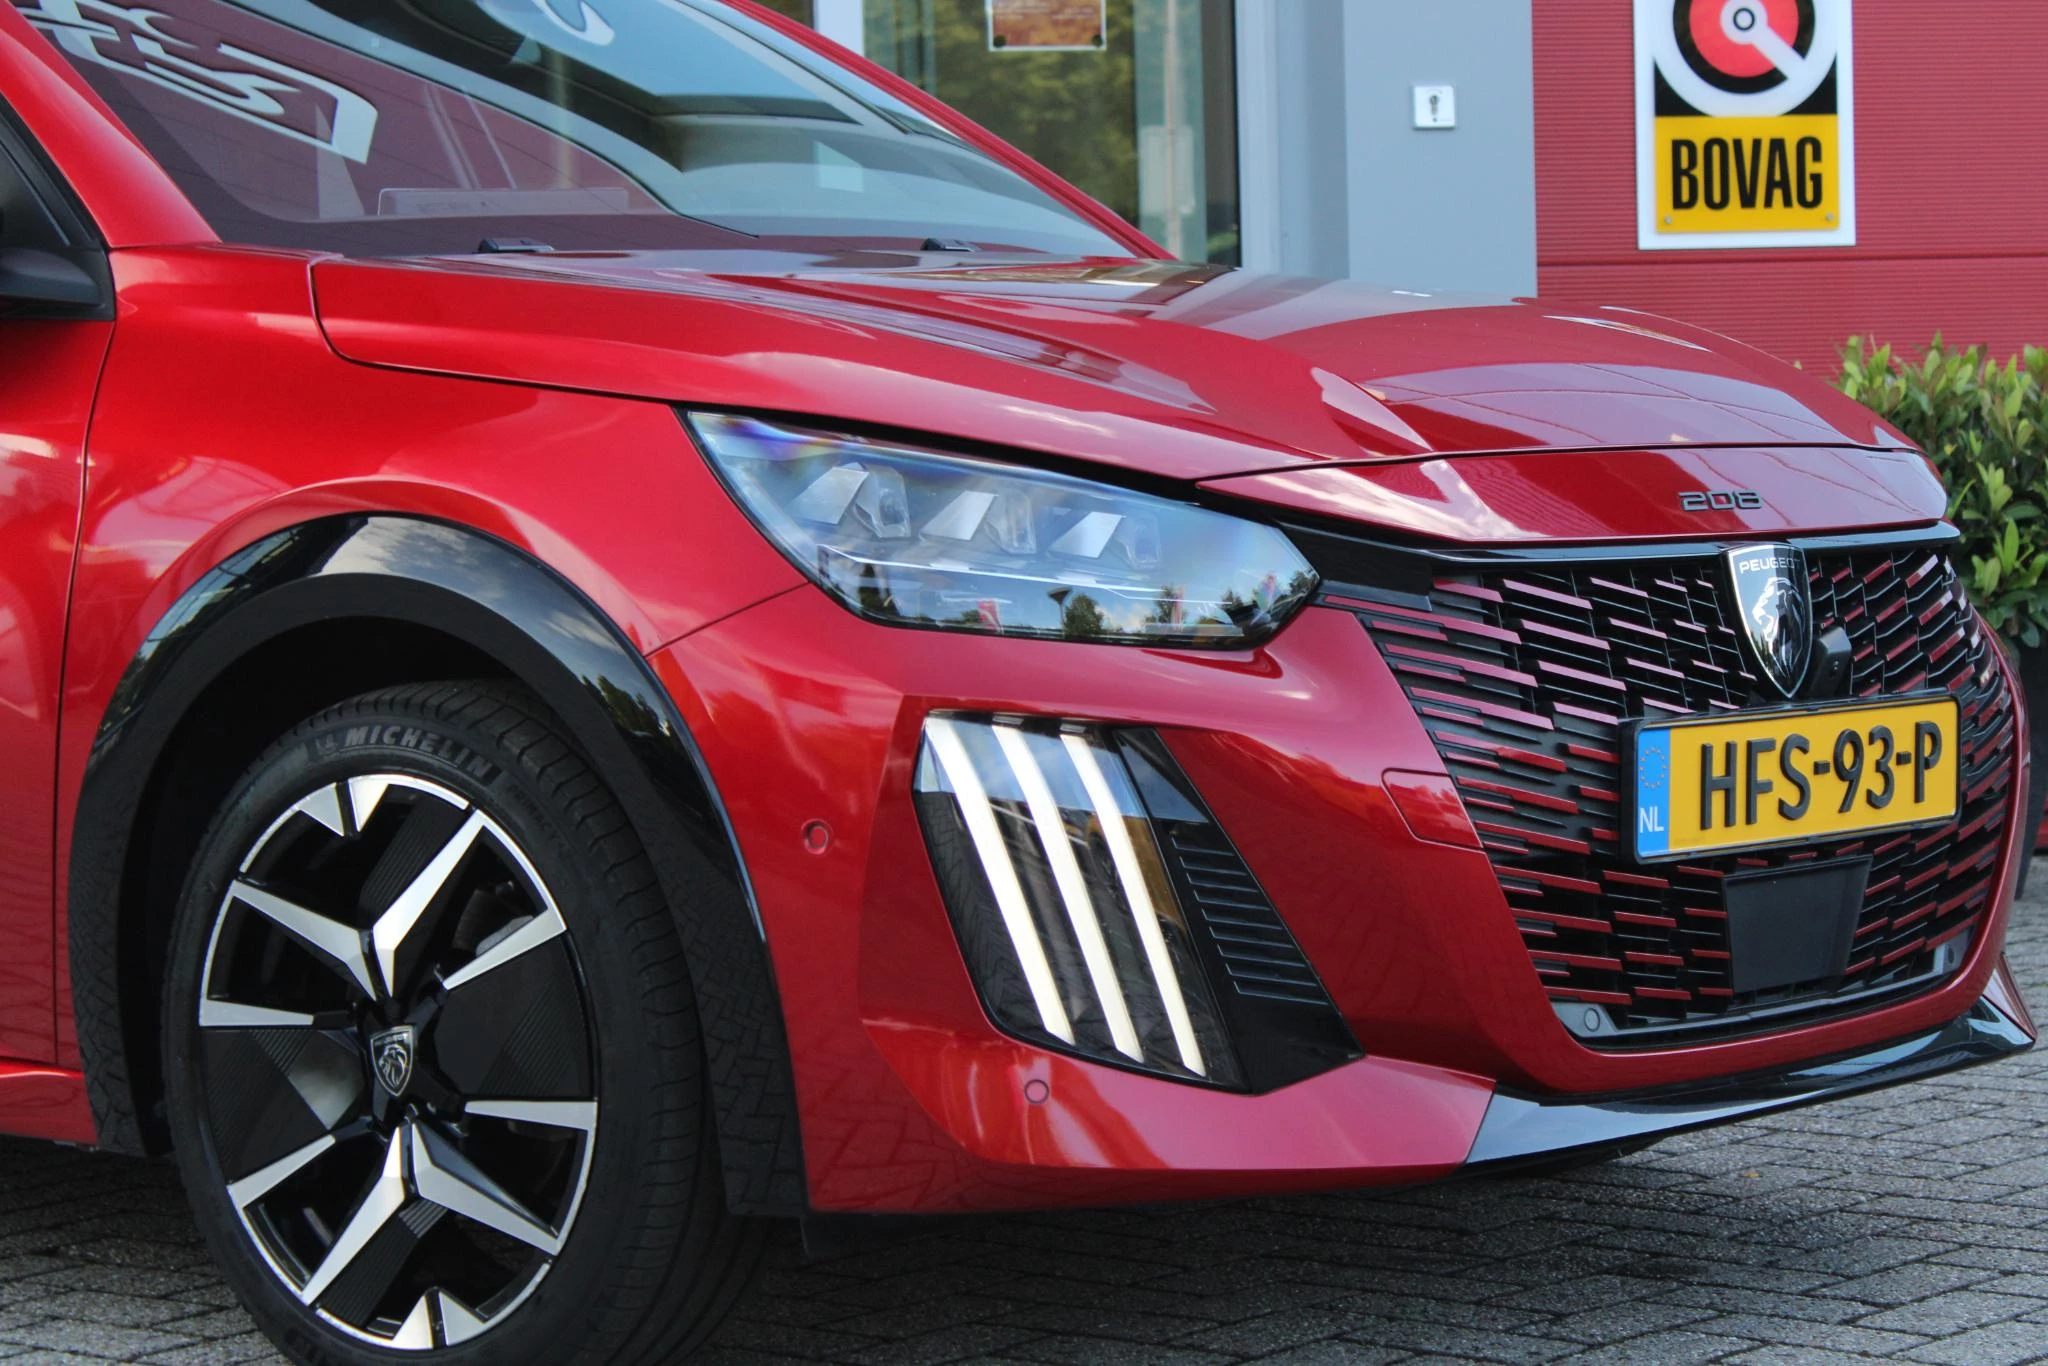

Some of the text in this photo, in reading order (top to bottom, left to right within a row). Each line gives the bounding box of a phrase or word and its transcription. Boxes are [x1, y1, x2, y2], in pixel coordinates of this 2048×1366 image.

[1671, 136, 1823, 211] BOVAG
[1678, 489, 1763, 512] 208
[344, 724, 493, 779] MICHELIN
[1700, 720, 1943, 831] HFS-93-P
[1639, 805, 1665, 834] NL
